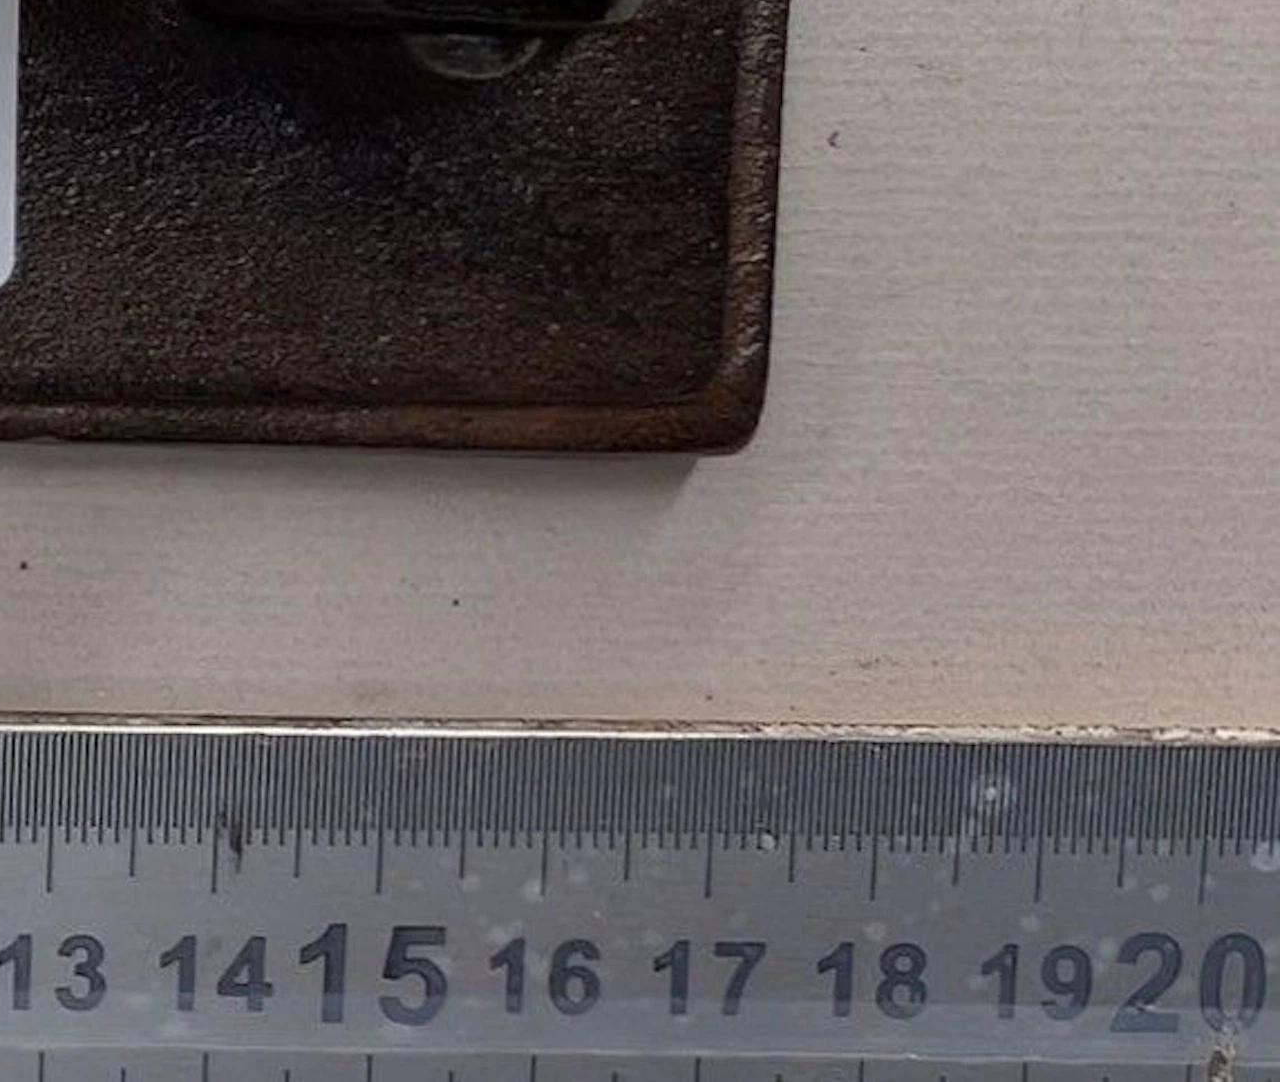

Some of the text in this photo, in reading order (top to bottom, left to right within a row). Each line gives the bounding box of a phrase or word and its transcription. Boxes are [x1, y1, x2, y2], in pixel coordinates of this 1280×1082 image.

[159, 935, 274, 1011] 14
[299, 923, 448, 1025] 15
[490, 937, 601, 1015] 16
[653, 940, 767, 1016] 17
[817, 942, 927, 1019] 18
[981, 944, 1093, 1020] 19
[1110, 932, 1267, 1033] 20
